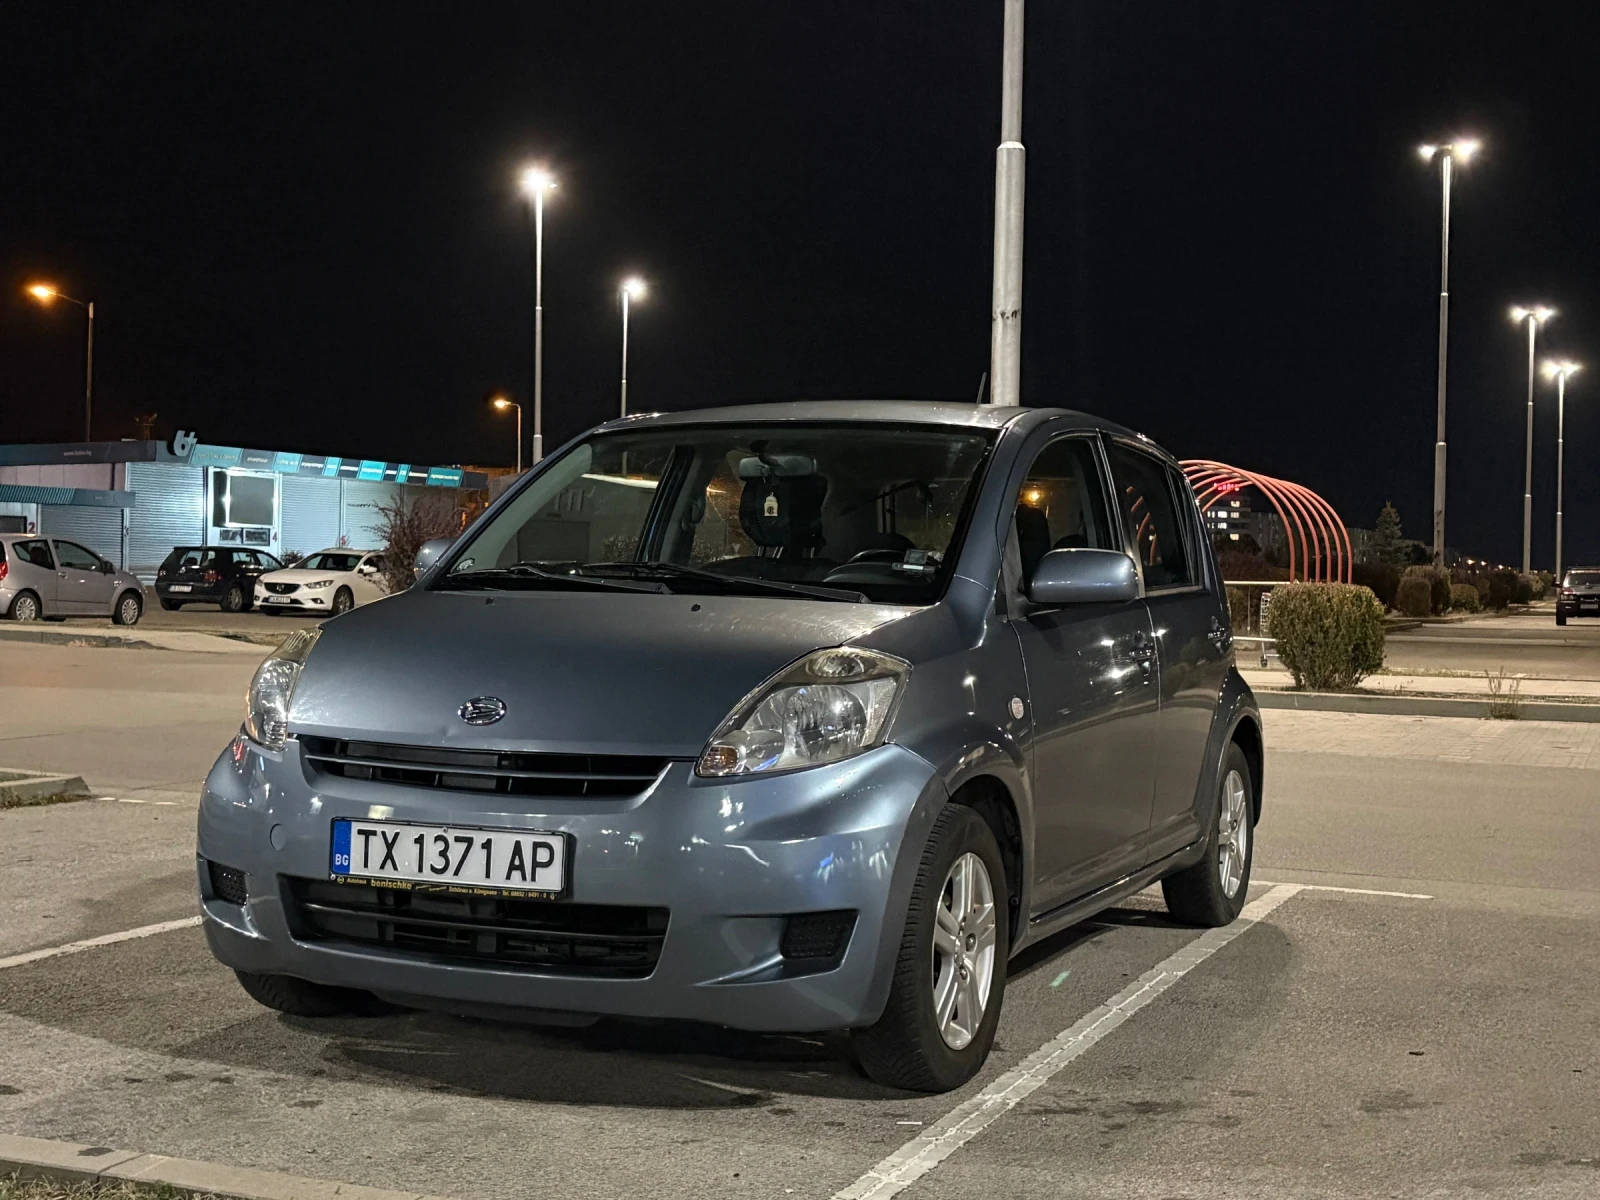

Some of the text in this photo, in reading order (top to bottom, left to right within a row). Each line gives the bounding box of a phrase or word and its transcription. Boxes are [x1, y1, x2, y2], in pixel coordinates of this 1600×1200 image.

[28, 522, 36, 534] 2
[335, 853, 349, 866] BG
[357, 828, 555, 882] TX 1371 AP
